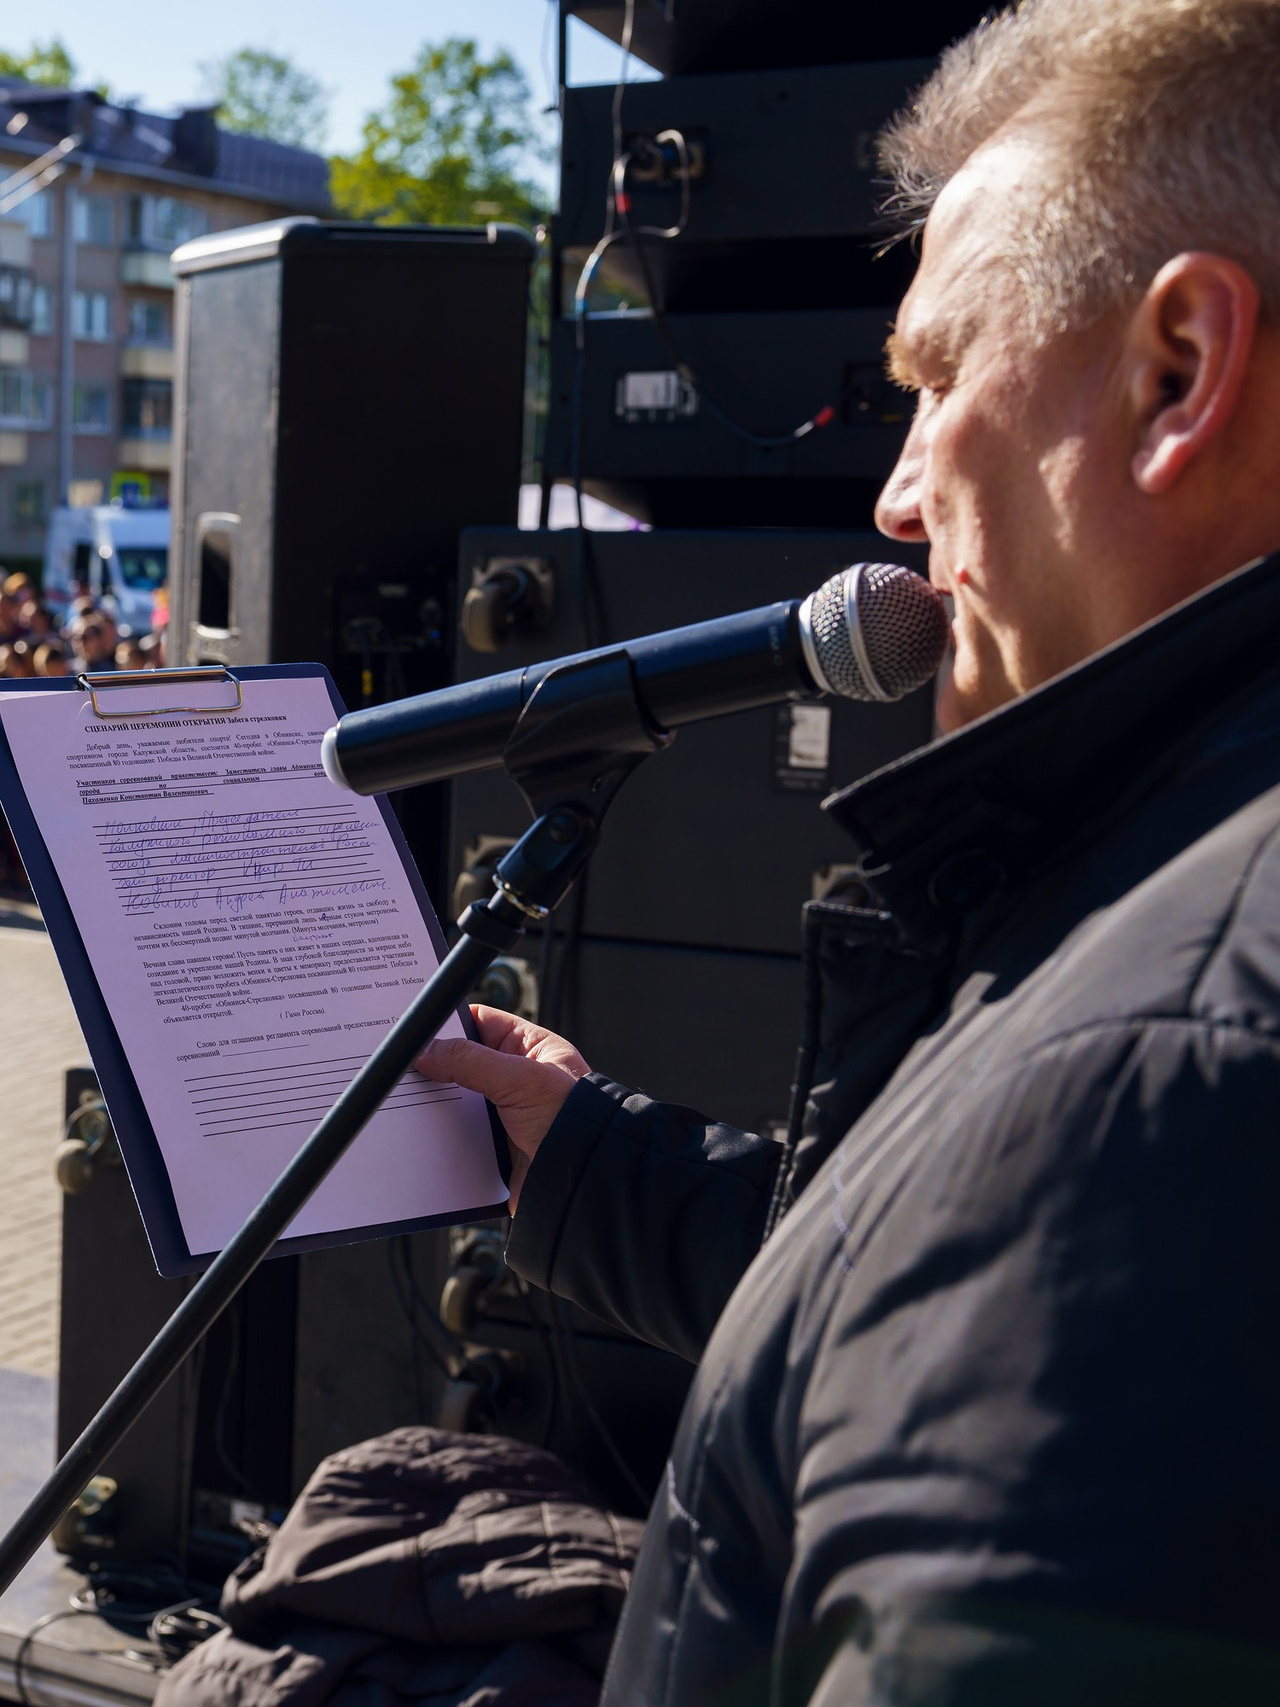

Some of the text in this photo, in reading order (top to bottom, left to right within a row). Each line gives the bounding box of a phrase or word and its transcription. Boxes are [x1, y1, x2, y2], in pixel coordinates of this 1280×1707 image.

[85, 715, 287, 734] СЦЕНАРИЙ ЦЕРЕМОНИИ ОТКРЫТИЯ Забега стрелковки
[66, 753, 103, 761] спортивном
[108, 751, 128, 759] городе
[133, 747, 166, 757] Калужской
[171, 746, 196, 754] области,
[201, 744, 230, 752] состоится
[234, 741, 262, 750] 40-пробег
[86, 742, 111, 752] Добрый
[137, 740, 170, 749] уважаемые
[175, 737, 204, 745] любители
[209, 734, 231, 743] спорта!
[69, 759, 112, 769] посвященный
[122, 758, 155, 766] годовщине
[157, 755, 181, 763] Победы
[187, 752, 212, 761] Великой
[213, 749, 257, 759] Отечественной
[258, 748, 276, 756] войне.
[133, 931, 179, 941] независимость
[182, 927, 202, 936] нашей
[203, 926, 229, 934] Родины.
[239, 922, 263, 930] тишине,
[265, 916, 299, 928] прерванной
[344, 911, 364, 919] стуком
[366, 908, 399, 917] метронома,
[153, 922, 182, 930] Склоним
[185, 919, 207, 927] головы
[210, 917, 227, 925] перед
[229, 912, 253, 922] светлой
[255, 911, 281, 919] памятью
[284, 909, 303, 917] героев,
[306, 905, 334, 914] отдавших
[366, 898, 389, 907] свободу
[137, 942, 160, 950] почтим
[170, 935, 212, 947] бессмертный
[234, 930, 260, 940] минутой
[261, 929, 291, 937] молчания.
[292, 926, 317, 935] (Минута
[318, 923, 347, 931] молчания,
[348, 918, 379, 928] метроном)
[143, 961, 166, 969] Вечная
[186, 956, 211, 964] павшим
[212, 951, 236, 961] героям!
[237, 951, 256, 959] Пусть
[257, 948, 278, 956] память
[321, 941, 340, 949] наших
[342, 938, 366, 947] сердцах,
[368, 934, 400, 944] вдохновляя
[146, 969, 179, 978] созидание
[187, 964, 223, 974] укрепление
[225, 960, 244, 969] нашей
[246, 959, 271, 967] Родины.
[295, 951, 322, 961] глубокой
[323, 947, 366, 958] благодарности
[375, 944, 396, 952] мирное
[153, 983, 214, 996] легкоатлетического
[216, 980, 240, 989] пробега
[241, 972, 306, 986] «Обнинск-Стрелковка
[307, 966, 347, 978] посвященный
[357, 963, 388, 972] годовщине
[390, 960, 413, 968] Победы
[164, 975, 191, 985] головой,
[193, 974, 211, 983] право
[213, 971, 245, 980] возложить
[247, 968, 265, 976] венки
[274, 965, 292, 974] цветы
[300, 961, 331, 970] мемориалу
[333, 955, 380, 967] предоставляется
[382, 951, 415, 962] участникам
[156, 988, 252, 1005] Великой Отечественной войне.
[181, 1002, 212, 1012] 40-пробег
[216, 994, 285, 1008] «Обнинск-Стрелковка»
[288, 987, 328, 999] посвященный
[341, 984, 372, 993] годовщине
[375, 979, 399, 989] Великой
[402, 977, 424, 985] Победы
[163, 1009, 234, 1023] объявляется открытой.
[301, 1007, 326, 1016] России).
[196, 1040, 216, 1048] Слово
[231, 1034, 264, 1044] оглашения
[266, 1030, 300, 1041] регламента
[302, 1023, 342, 1035] соревнований
[344, 1018, 390, 1030] предоставляется
[176, 1049, 220, 1062] соревнований
